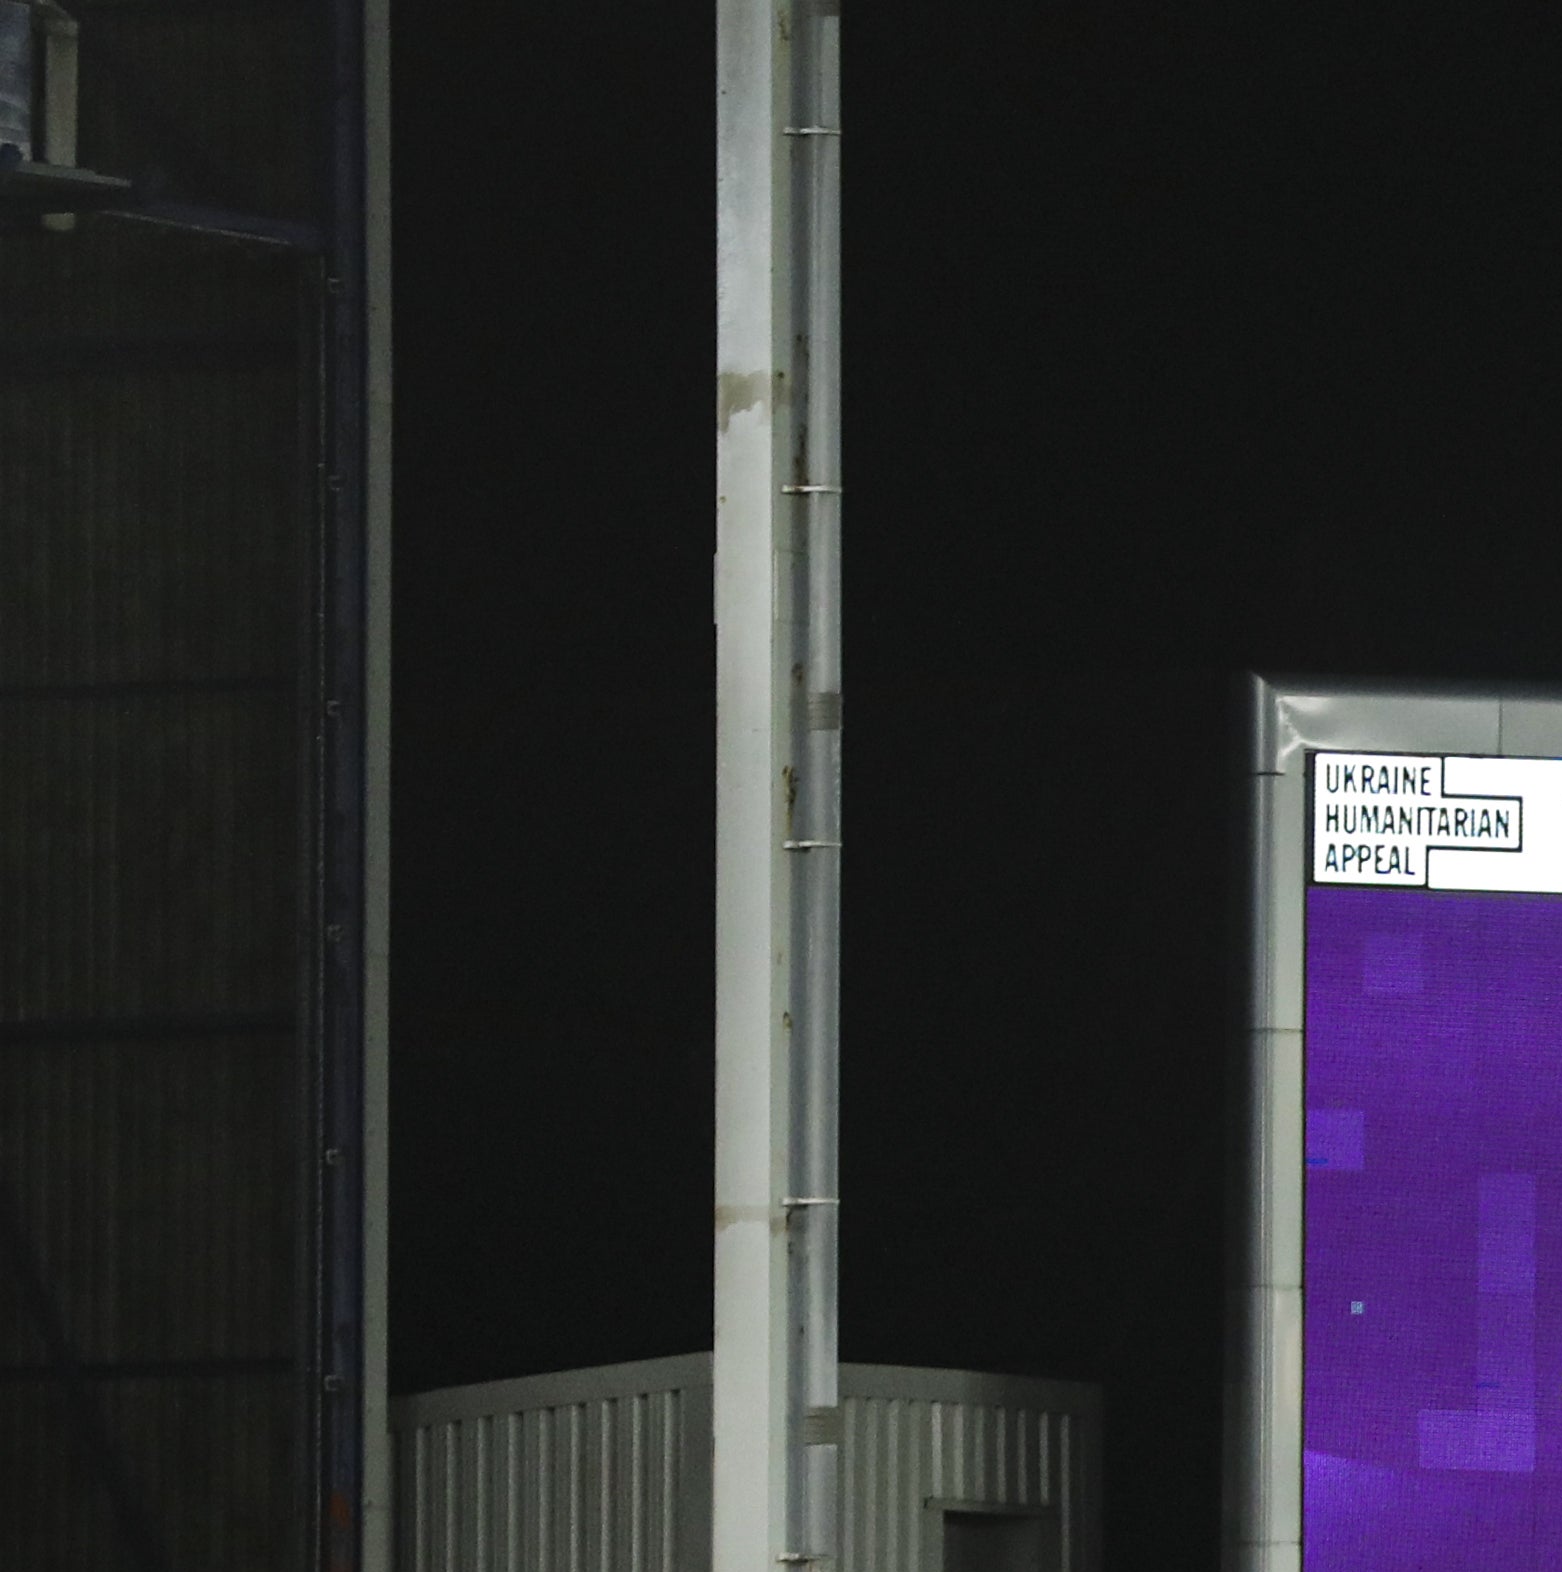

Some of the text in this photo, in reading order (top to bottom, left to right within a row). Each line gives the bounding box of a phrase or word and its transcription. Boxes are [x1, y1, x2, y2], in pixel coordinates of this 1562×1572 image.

[1325, 763, 1432, 796] UKRAINE
[1325, 804, 1510, 838] HUMANITARIAN
[1325, 843, 1415, 876] APPEAL
